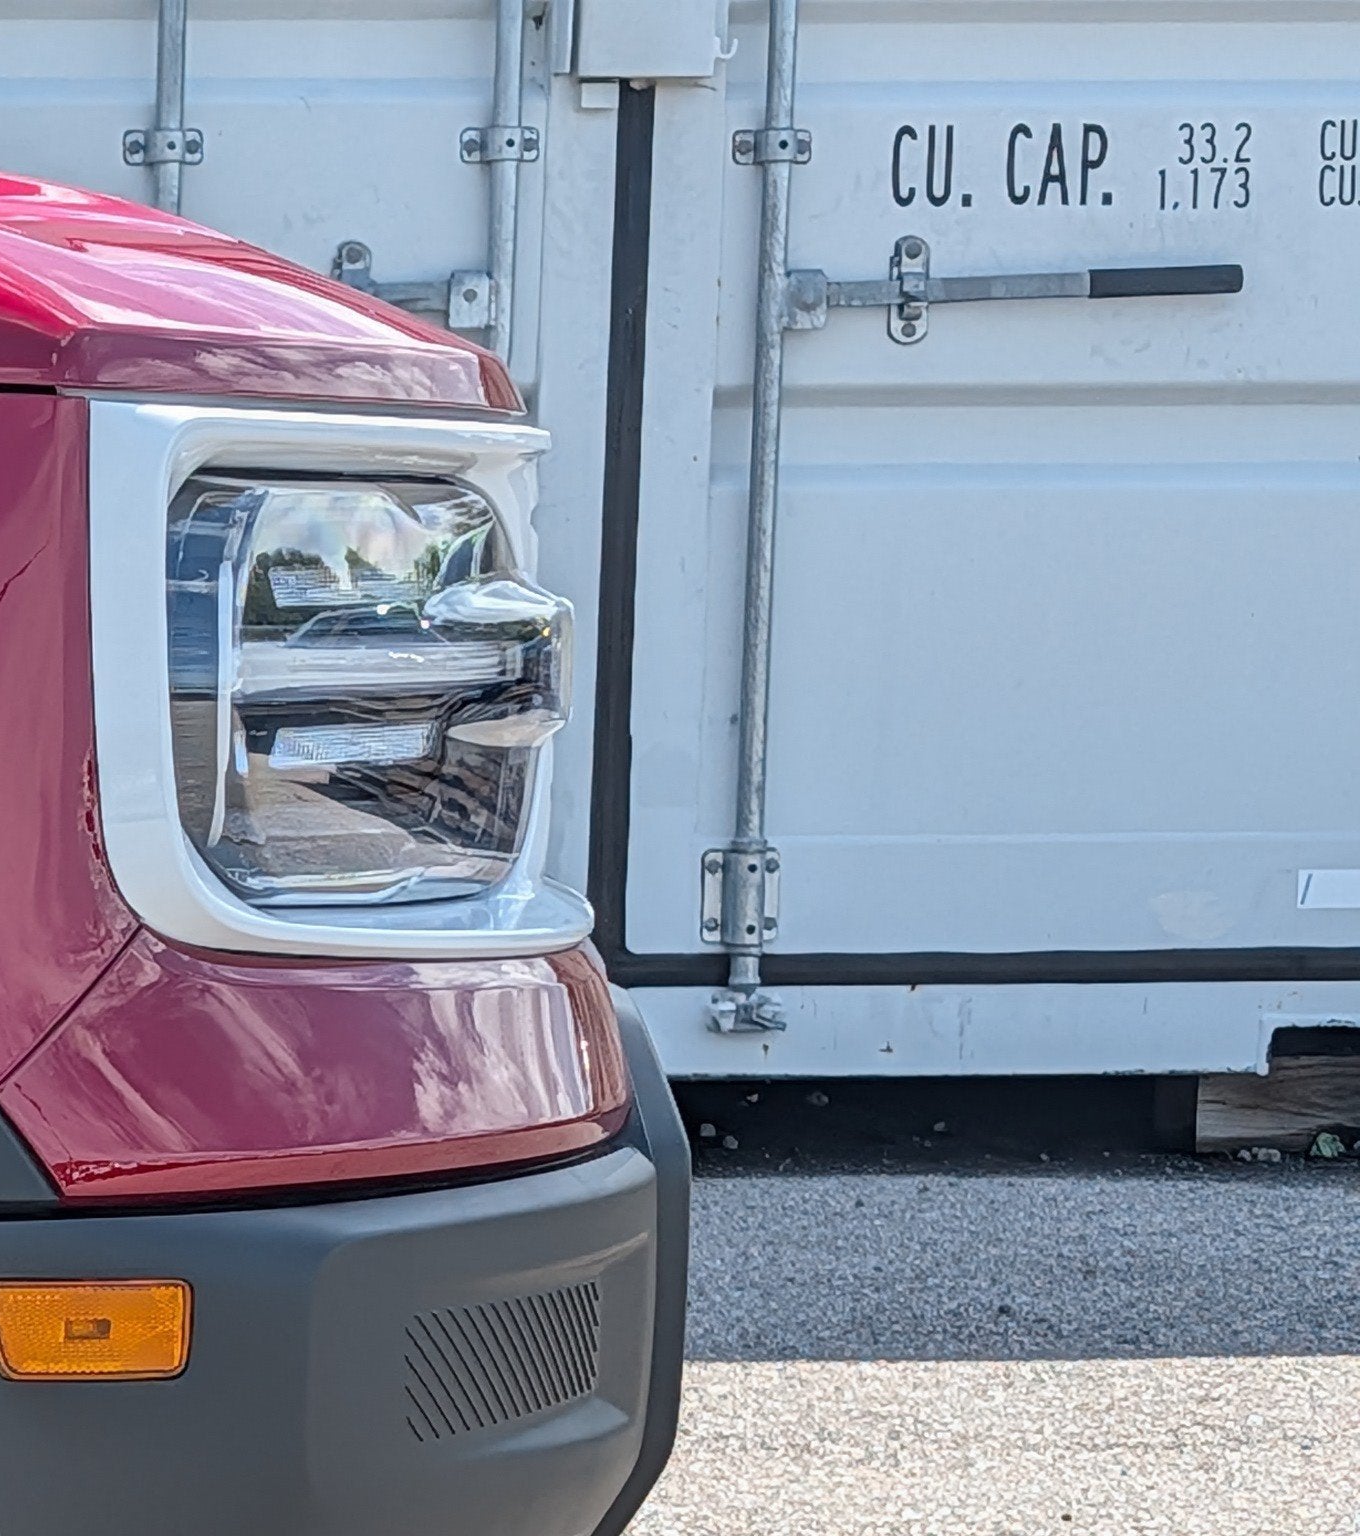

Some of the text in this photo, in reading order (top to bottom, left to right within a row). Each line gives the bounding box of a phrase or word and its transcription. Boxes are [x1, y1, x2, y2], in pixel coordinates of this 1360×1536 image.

[891, 123, 1113, 208] CU. CAP.
[1178, 122, 1252, 165] 33.2
[1158, 166, 1250, 210] 1,173
